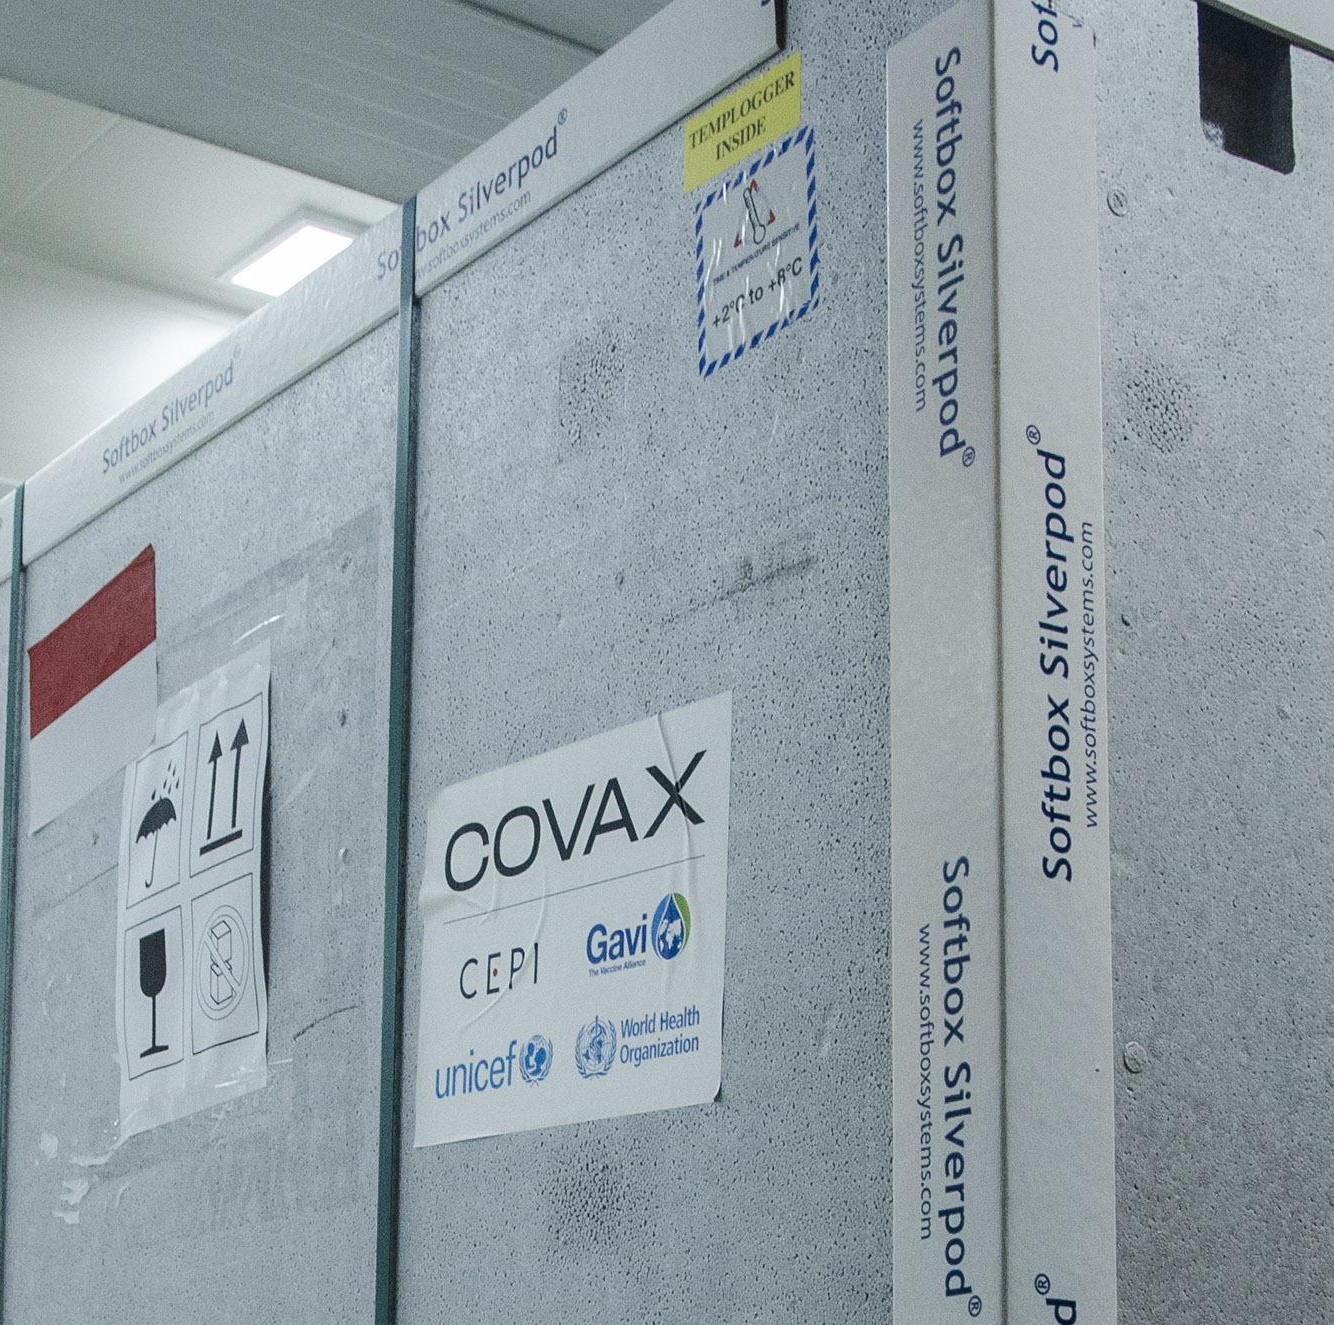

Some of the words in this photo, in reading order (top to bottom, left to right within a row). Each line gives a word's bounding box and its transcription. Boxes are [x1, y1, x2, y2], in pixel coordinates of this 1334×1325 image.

[689, 70, 796, 149] TEMPLOGGER
[716, 115, 767, 161] INSIDE
[935, 46, 963, 227] Softbox
[377, 210, 450, 281] Sobox
[912, 119, 928, 412] www.softboxsystems.com
[748, 286, 764, 305] to
[102, 419, 158, 475] Softbox
[1078, 521, 1099, 829] www.softboxsystems.com
[444, 749, 708, 892] COVAX
[1041, 699, 1073, 882] Softbox
[459, 941, 539, 1000] CEPI
[586, 912, 648, 965] Gavi
[942, 855, 970, 1047] Softbox
[588, 967, 600, 978] The
[620, 1011, 656, 1039] World
[660, 1004, 700, 1032] Health
[620, 1033, 699, 1068] Organization
[435, 1039, 517, 1100] unicef
[917, 923, 935, 1240] www.softboxsystems.com
